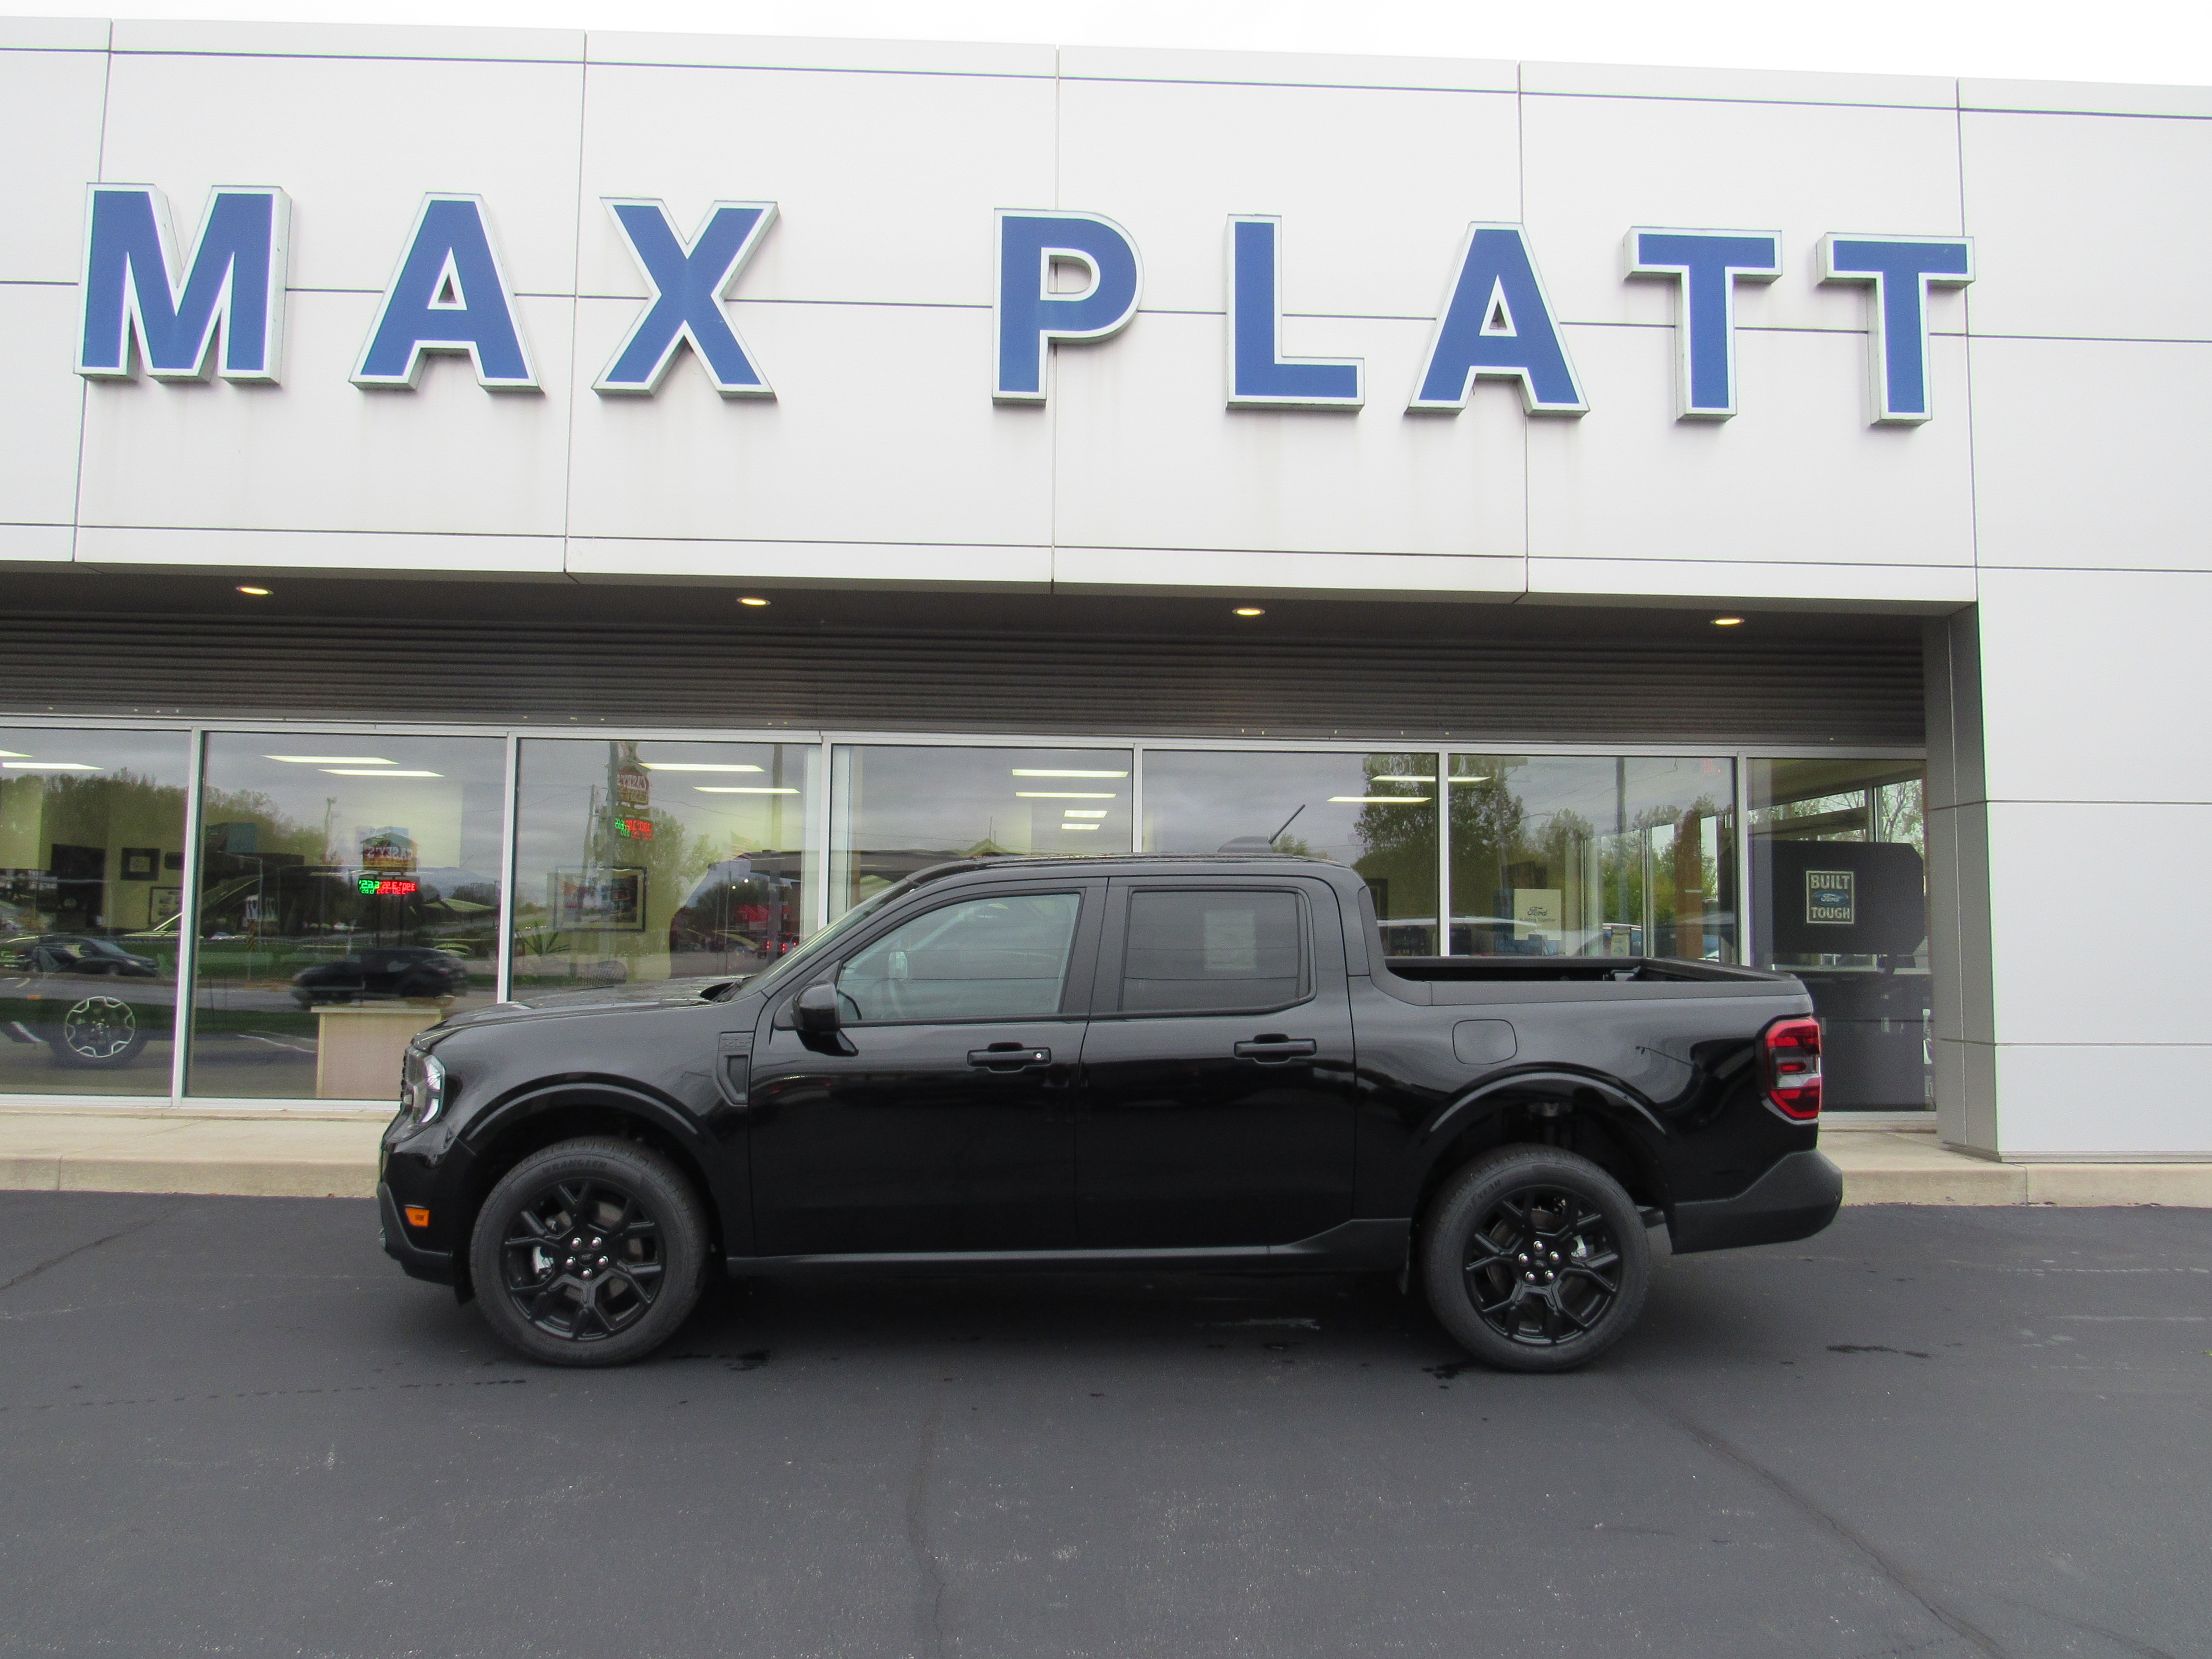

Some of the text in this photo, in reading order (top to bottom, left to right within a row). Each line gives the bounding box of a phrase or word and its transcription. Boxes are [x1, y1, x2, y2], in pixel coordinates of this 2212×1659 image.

[74, 183, 1975, 427] MAX PLATT
[1811, 875, 1850, 889] BUILT
[1821, 893, 1839, 902] Ford
[1527, 906, 1548, 916] Ford
[1811, 907, 1850, 919] TOUGH
